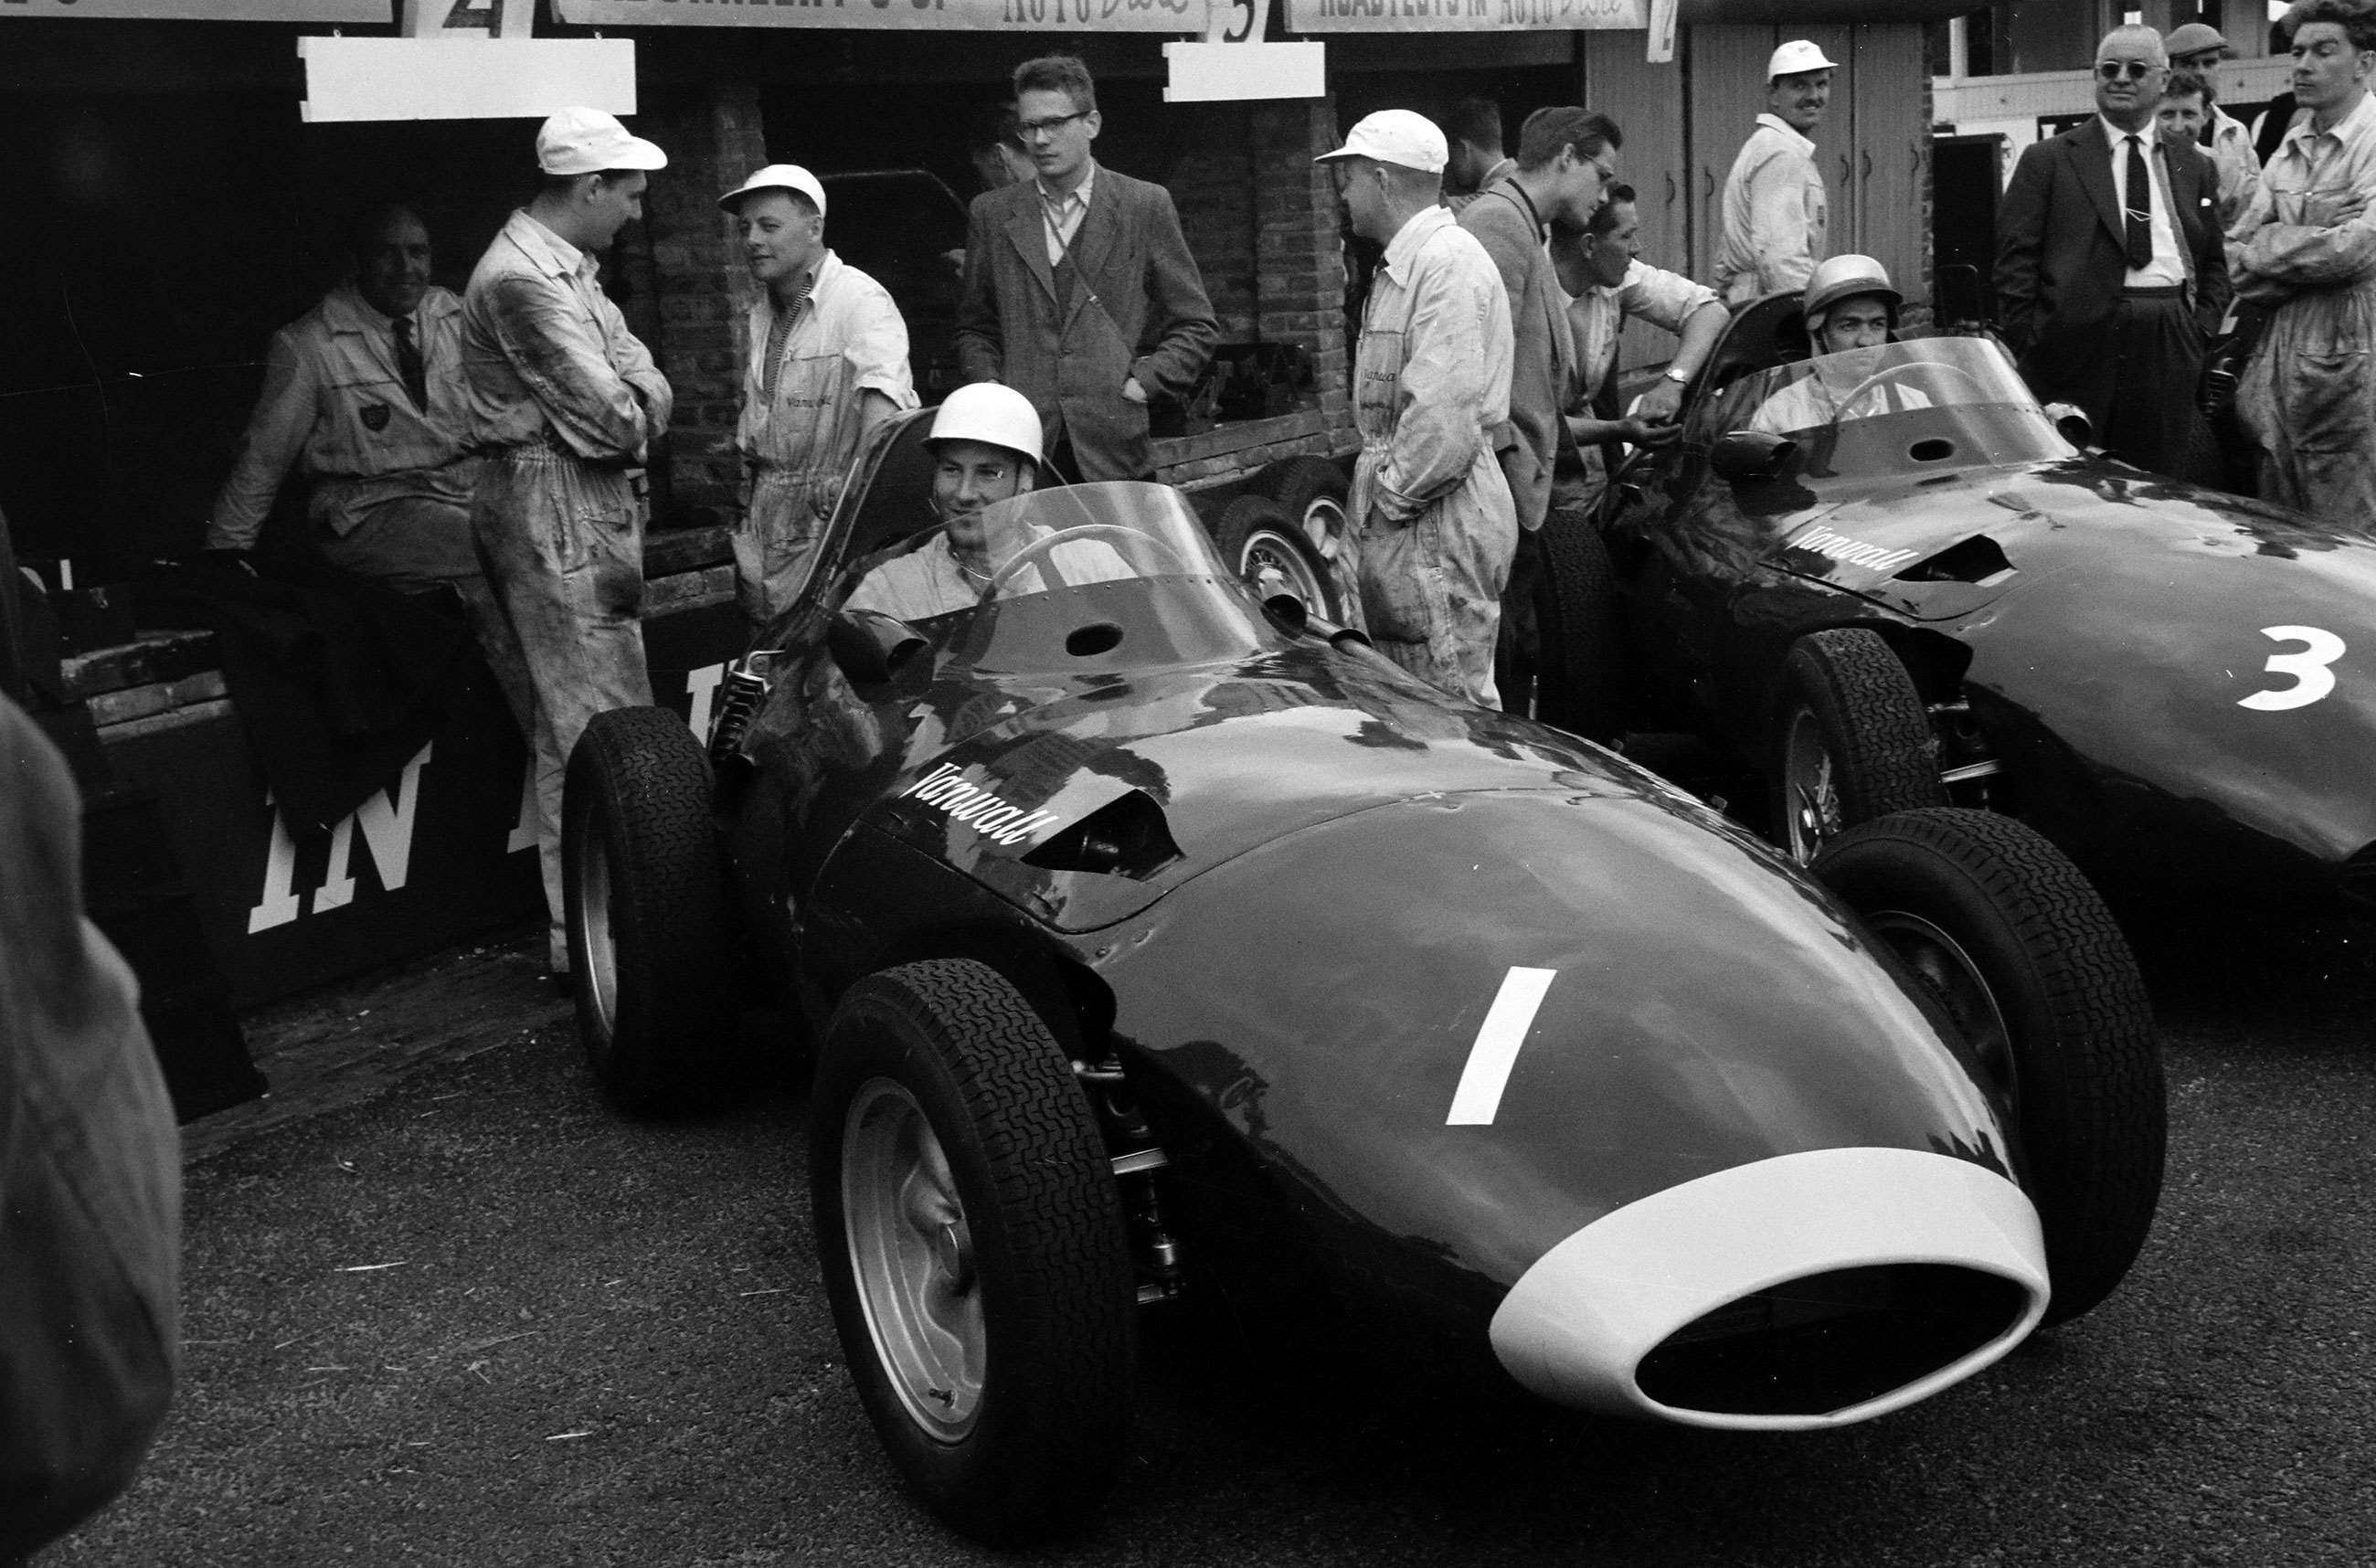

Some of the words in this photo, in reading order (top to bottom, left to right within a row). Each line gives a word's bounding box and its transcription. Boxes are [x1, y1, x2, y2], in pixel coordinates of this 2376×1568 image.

[1785, 525, 1920, 571] Vanwall
[2237, 625, 2346, 711] 3
[898, 762, 1059, 845] Vanwall
[1446, 966, 1557, 1125] 1
